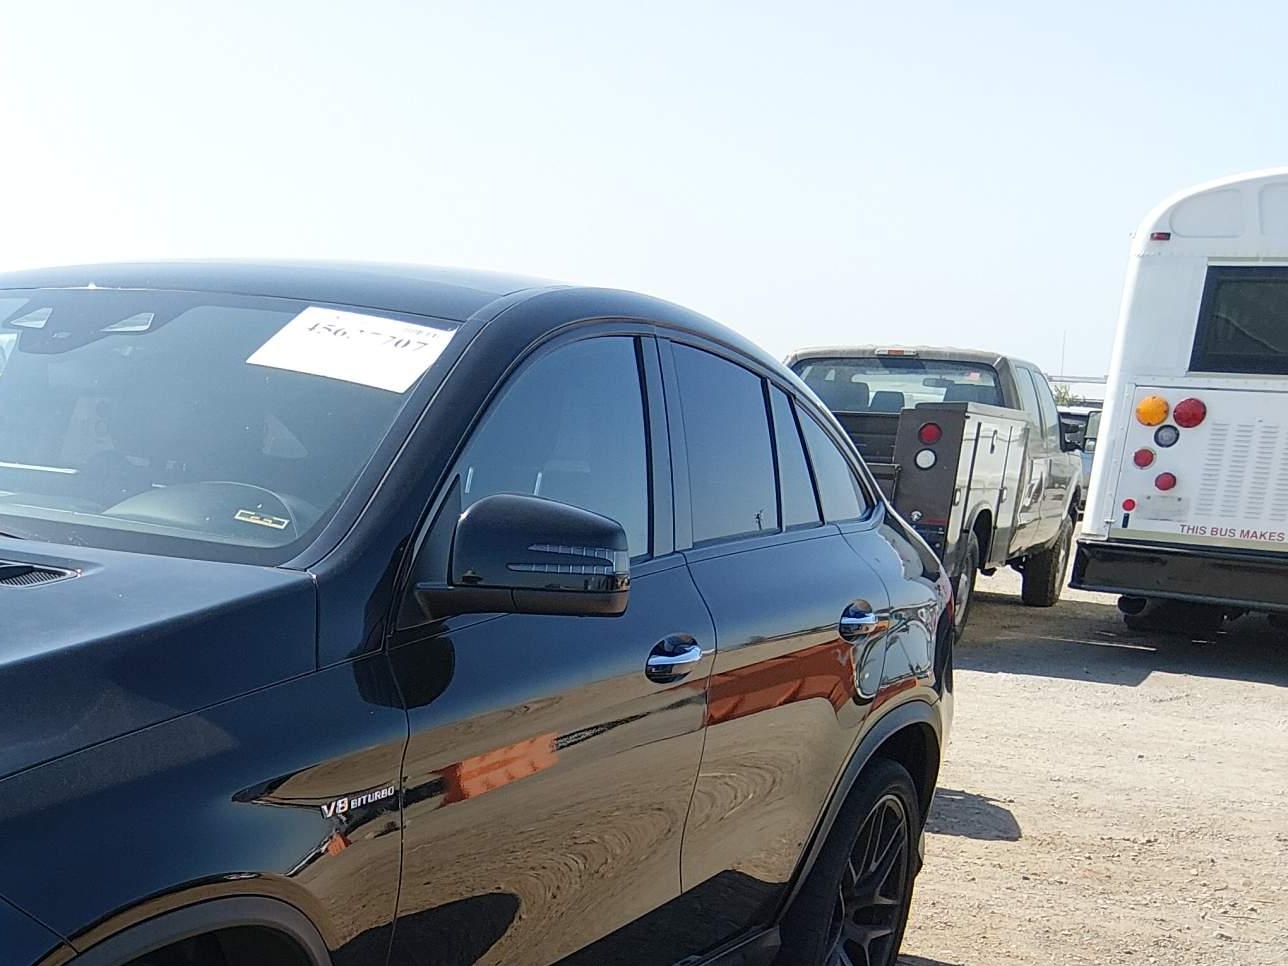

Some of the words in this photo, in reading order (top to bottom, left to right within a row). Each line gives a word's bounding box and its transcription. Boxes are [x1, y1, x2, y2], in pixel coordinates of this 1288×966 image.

[307, 321, 429, 352] 456707
[1179, 524, 1207, 536] THIS
[1210, 527, 1236, 538] BUS
[1239, 529, 1286, 542] MAKES
[320, 797, 350, 818] V8
[350, 785, 395, 809] BITURBO
